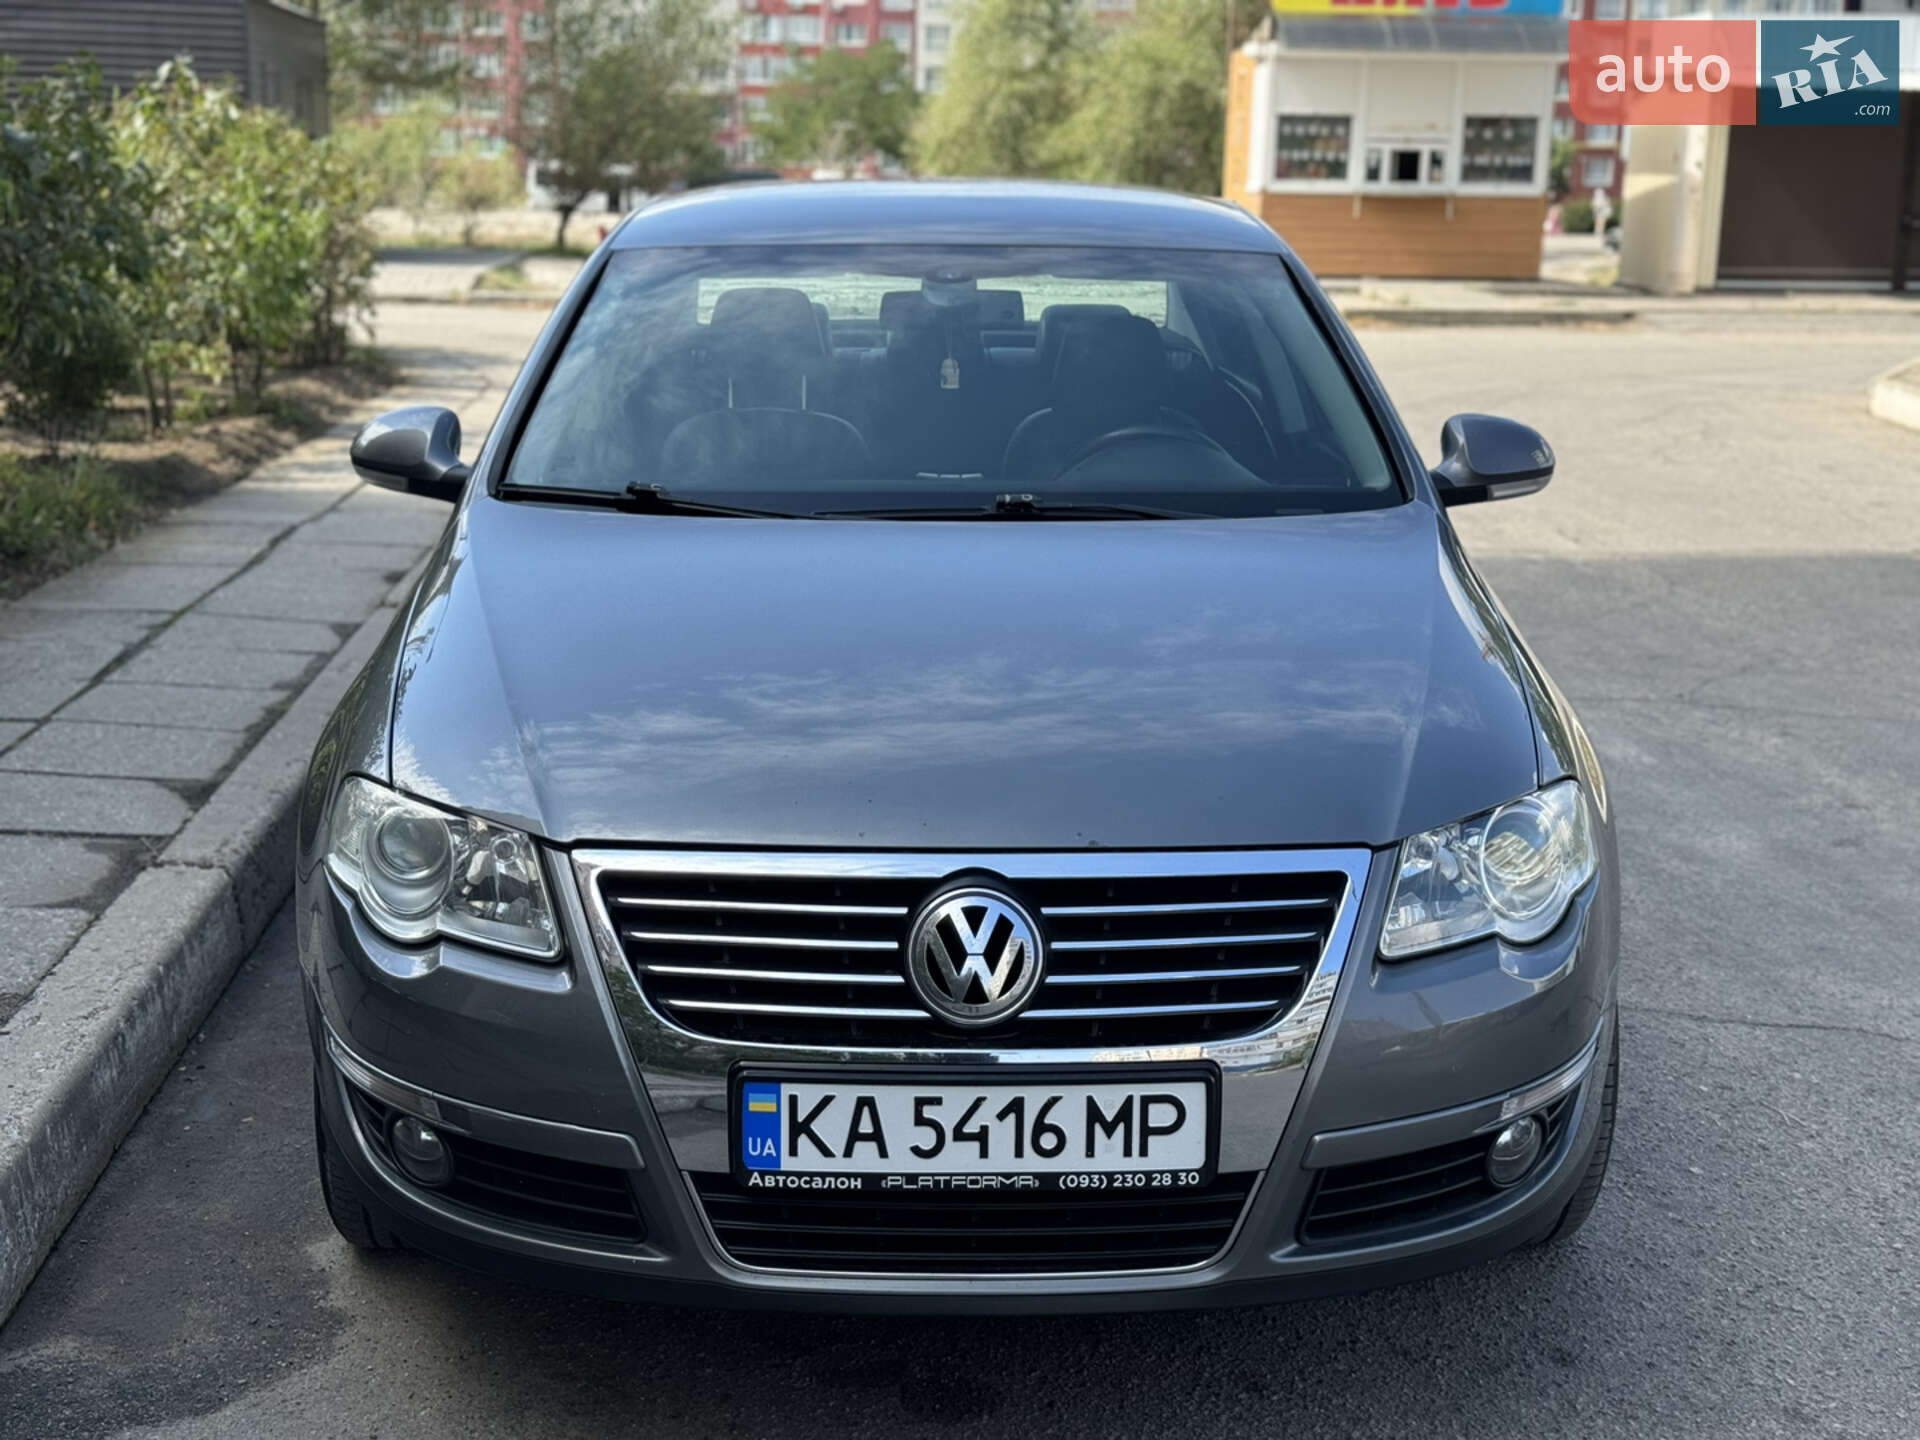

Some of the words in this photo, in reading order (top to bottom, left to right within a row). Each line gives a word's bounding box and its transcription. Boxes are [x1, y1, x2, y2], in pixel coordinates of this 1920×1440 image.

[788, 1094, 889, 1159] KA
[909, 1096, 1067, 1159] 5416
[1085, 1094, 1187, 1159] MP
[748, 1137, 777, 1157] UA
[748, 1171, 862, 1190] Автосалон
[1058, 1173, 1108, 1190] (093)
[1112, 1173, 1146, 1188] 230
[1151, 1172, 1172, 1187] 28
[1177, 1171, 1200, 1186] 30
